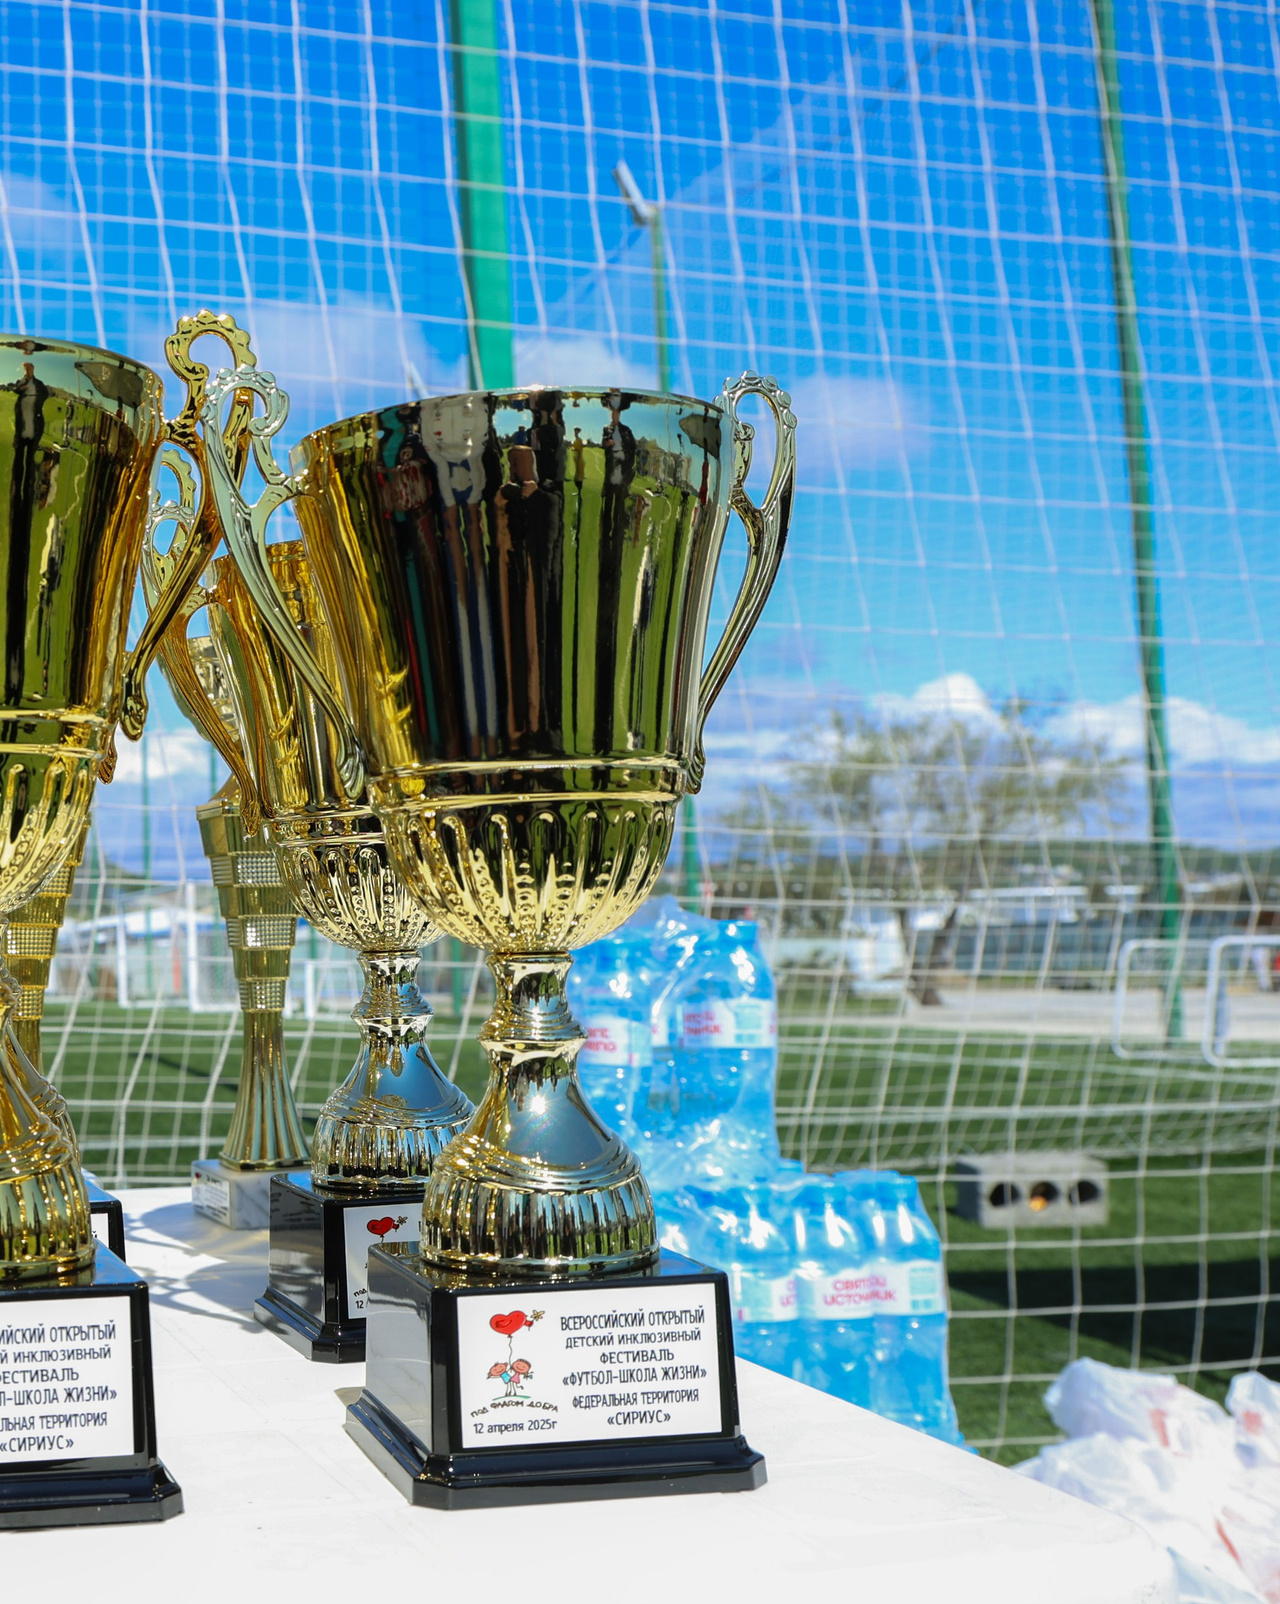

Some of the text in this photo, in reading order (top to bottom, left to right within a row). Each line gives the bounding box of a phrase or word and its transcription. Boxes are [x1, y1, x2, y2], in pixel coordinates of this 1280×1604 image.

[355, 1300, 364, 1309] 12
[560, 1305, 705, 1331] ВСЕРОССИЙСКИЙ ОТКРЫТЫЙ
[49, 1320, 116, 1342] ОТКРЫТЫЙ
[565, 1327, 701, 1349] ДЕТСКИЙ ИНКЛЮЗИВНЫЙ
[13, 1344, 111, 1363] ИНКЛЮЗИВНЫЙ
[600, 1349, 674, 1364] ФЕСТИВАЛЬ
[661, 1365, 707, 1381] ЖИЗНИ»
[63, 1386, 117, 1403] ЖИЗНИ»
[572, 1389, 699, 1410] ФЕДЕРАЛЬНАЯ ТЕРРИТОРИЯ
[490, 1400, 524, 1409] ФЛАГОМ
[526, 1401, 558, 1412] ДОБРА
[39, 1412, 108, 1429] ТЕРРИТОРИЯ
[607, 1410, 671, 1425] «СИРИУС»
[473, 1419, 557, 1435] 12 апреля 2025г
[0, 1435, 74, 1452] «СИРИУС»
